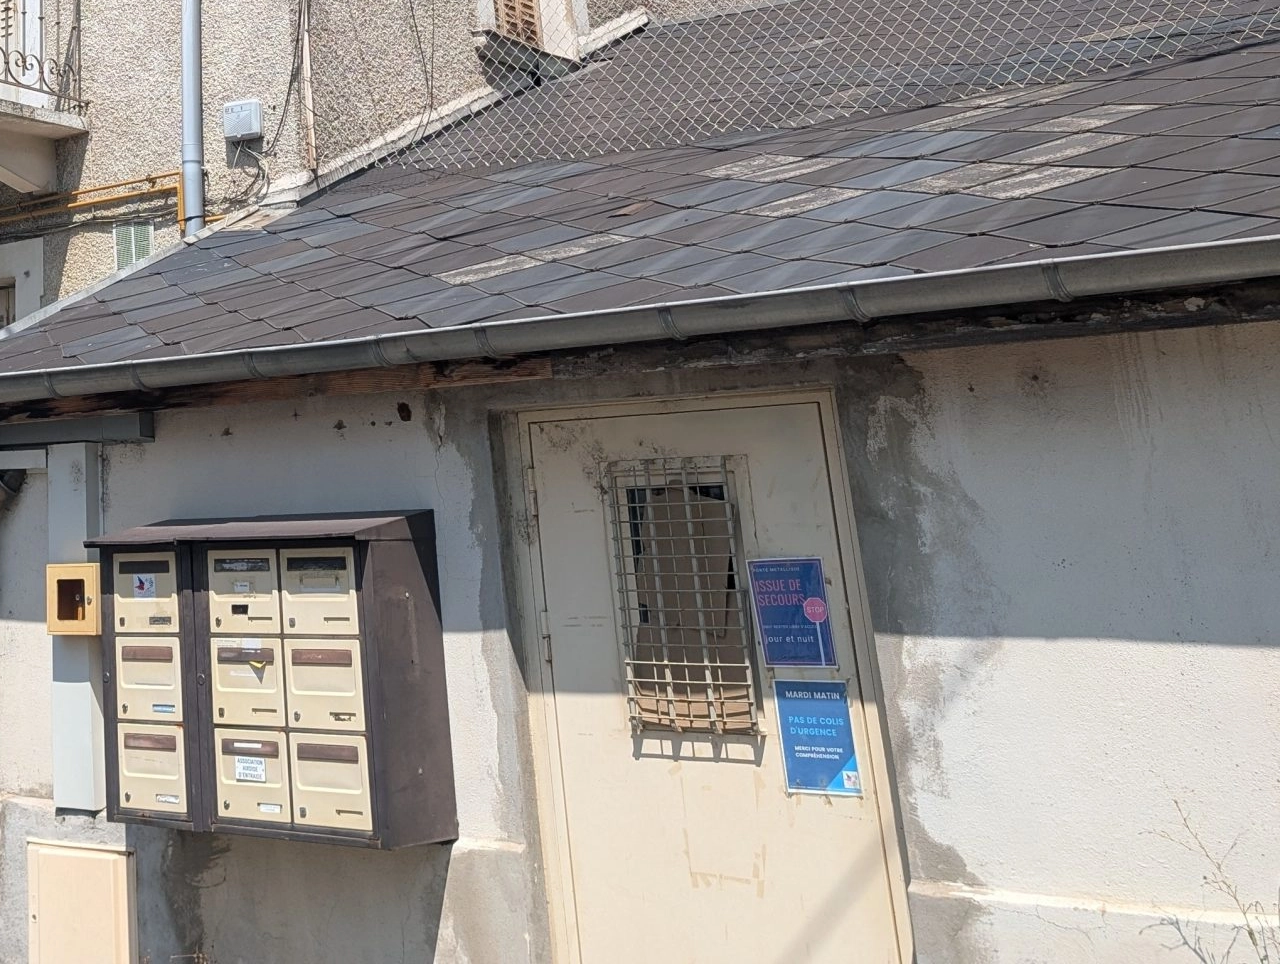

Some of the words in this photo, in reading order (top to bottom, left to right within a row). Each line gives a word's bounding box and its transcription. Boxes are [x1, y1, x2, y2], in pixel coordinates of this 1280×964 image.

[754, 579, 785, 593] ISSUE
[788, 579, 802, 591] DE
[758, 593, 806, 606] SECOURS
[797, 635, 814, 643] nuit
[785, 690, 812, 699] MARDI
[813, 691, 840, 700] MATIN
[788, 716, 805, 724] PAS
[806, 716, 818, 725] DE
[820, 717, 844, 726] COLIS
[790, 726, 837, 736] D'URGENCE
[826, 746, 844, 754] VOTRE
[237, 757, 263, 766] ASSOCIATION
